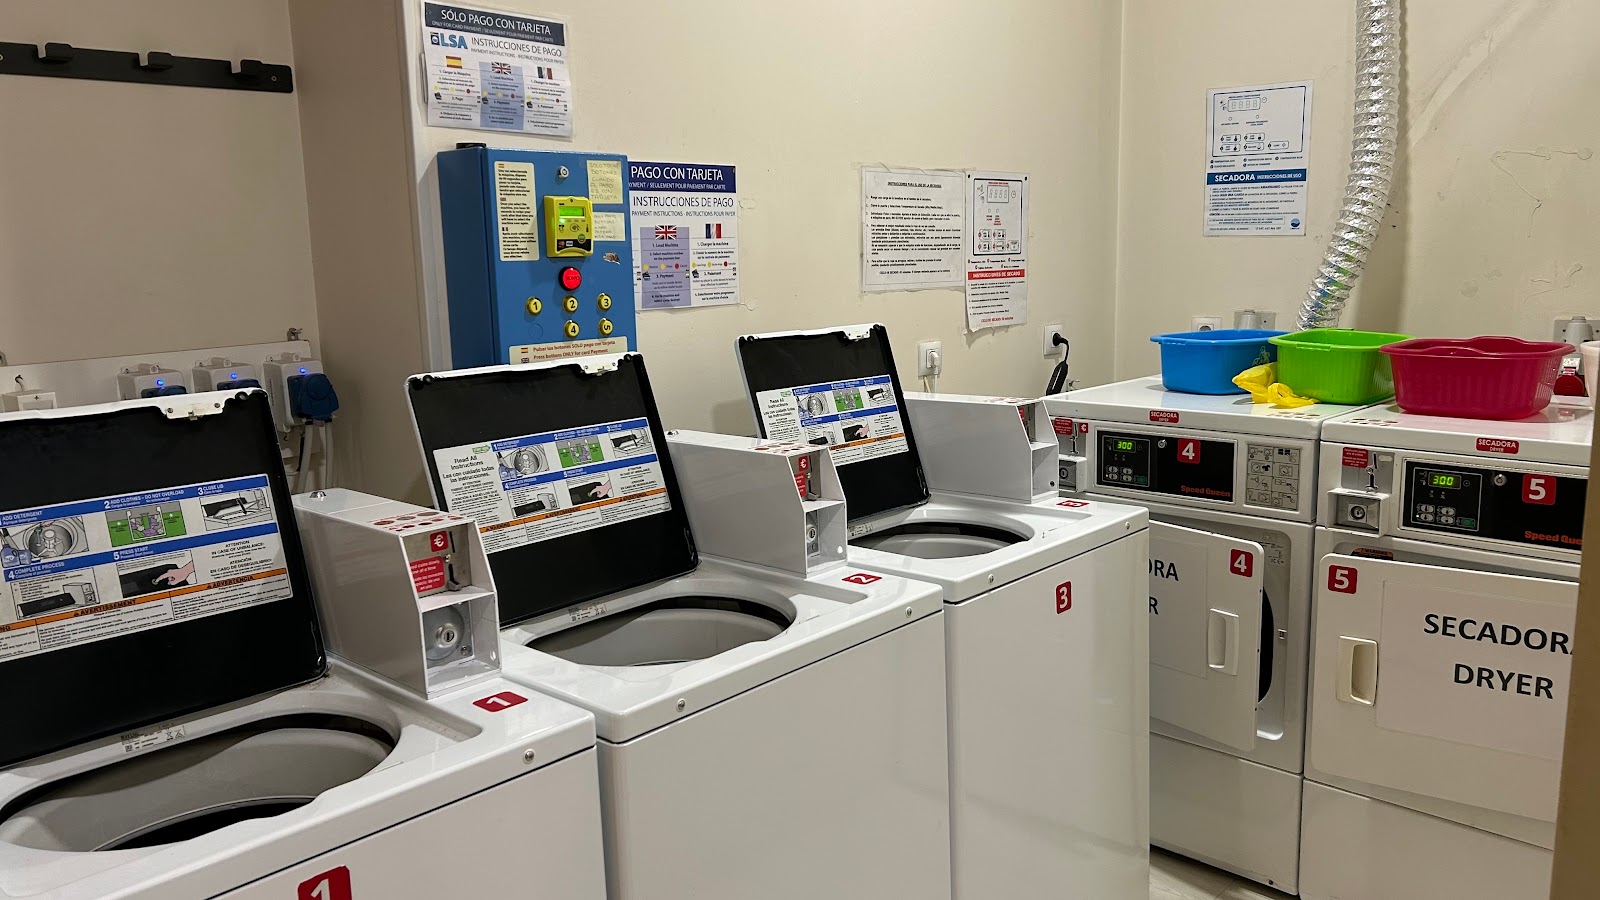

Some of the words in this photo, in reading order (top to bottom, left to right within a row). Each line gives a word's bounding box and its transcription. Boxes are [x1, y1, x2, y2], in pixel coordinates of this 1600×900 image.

[441, 9, 466, 23] SÓLO
[468, 15, 493, 26] PAGO
[495, 18, 515, 29] CON
[515, 21, 551, 35] TARJETA
[471, 37, 531, 53] INSTRUCCIONES
[531, 45, 541, 54] DE
[543, 47, 562, 57] PAGO
[631, 166, 661, 179] PAGO
[663, 167, 685, 180] CON
[686, 168, 723, 181] TARJETA
[1214, 173, 1256, 182] SECADORA
[633, 196, 700, 207] INSTRUCCIONES
[701, 197, 712, 207] DE
[713, 197, 734, 208] PAGO
[533, 302, 539, 310] 1
[570, 299, 576, 309] 2
[604, 298, 609, 307] 3
[571, 325, 576, 334] 4
[1150, 411, 1178, 419] SECADORA
[1116, 440, 1133, 450] 300
[1478, 438, 1517, 448] SECADORA
[1181, 442, 1195, 460] 4
[563, 470, 568, 478] 5
[1432, 474, 1454, 486] 300
[197, 487, 204, 495] 3
[1180, 485, 1205, 494] Speed
[1205, 487, 1231, 497] Queen
[1528, 478, 1546, 500] 5
[103, 500, 111, 509] 2
[120, 495, 141, 503] CLOTHES
[161, 489, 185, 498] OVERLOAD
[13, 511, 43, 520] DETERGENT
[434, 534, 445, 547] €
[1524, 530, 1560, 542] Speed
[225, 540, 250, 548] ATTENTION
[113, 551, 120, 560] 5
[119, 548, 134, 556] PRESS
[229, 557, 252, 565] ATENCIÓN
[1233, 553, 1247, 573] 4
[8, 571, 16, 579] 4
[14, 565, 42, 575] COMPLETE
[41, 561, 65, 569] PROCESS
[212, 575, 255, 589] ADVERTENCIA
[849, 575, 876, 583] 2
[1334, 569, 1350, 590] 5
[1059, 585, 1069, 609] 3
[80, 599, 137, 616] AVERTISSEMENT
[1423, 613, 1574, 655] SECADOR
[1454, 663, 1554, 700] DRYER
[486, 696, 512, 707] 1
[310, 878, 331, 900] 1
